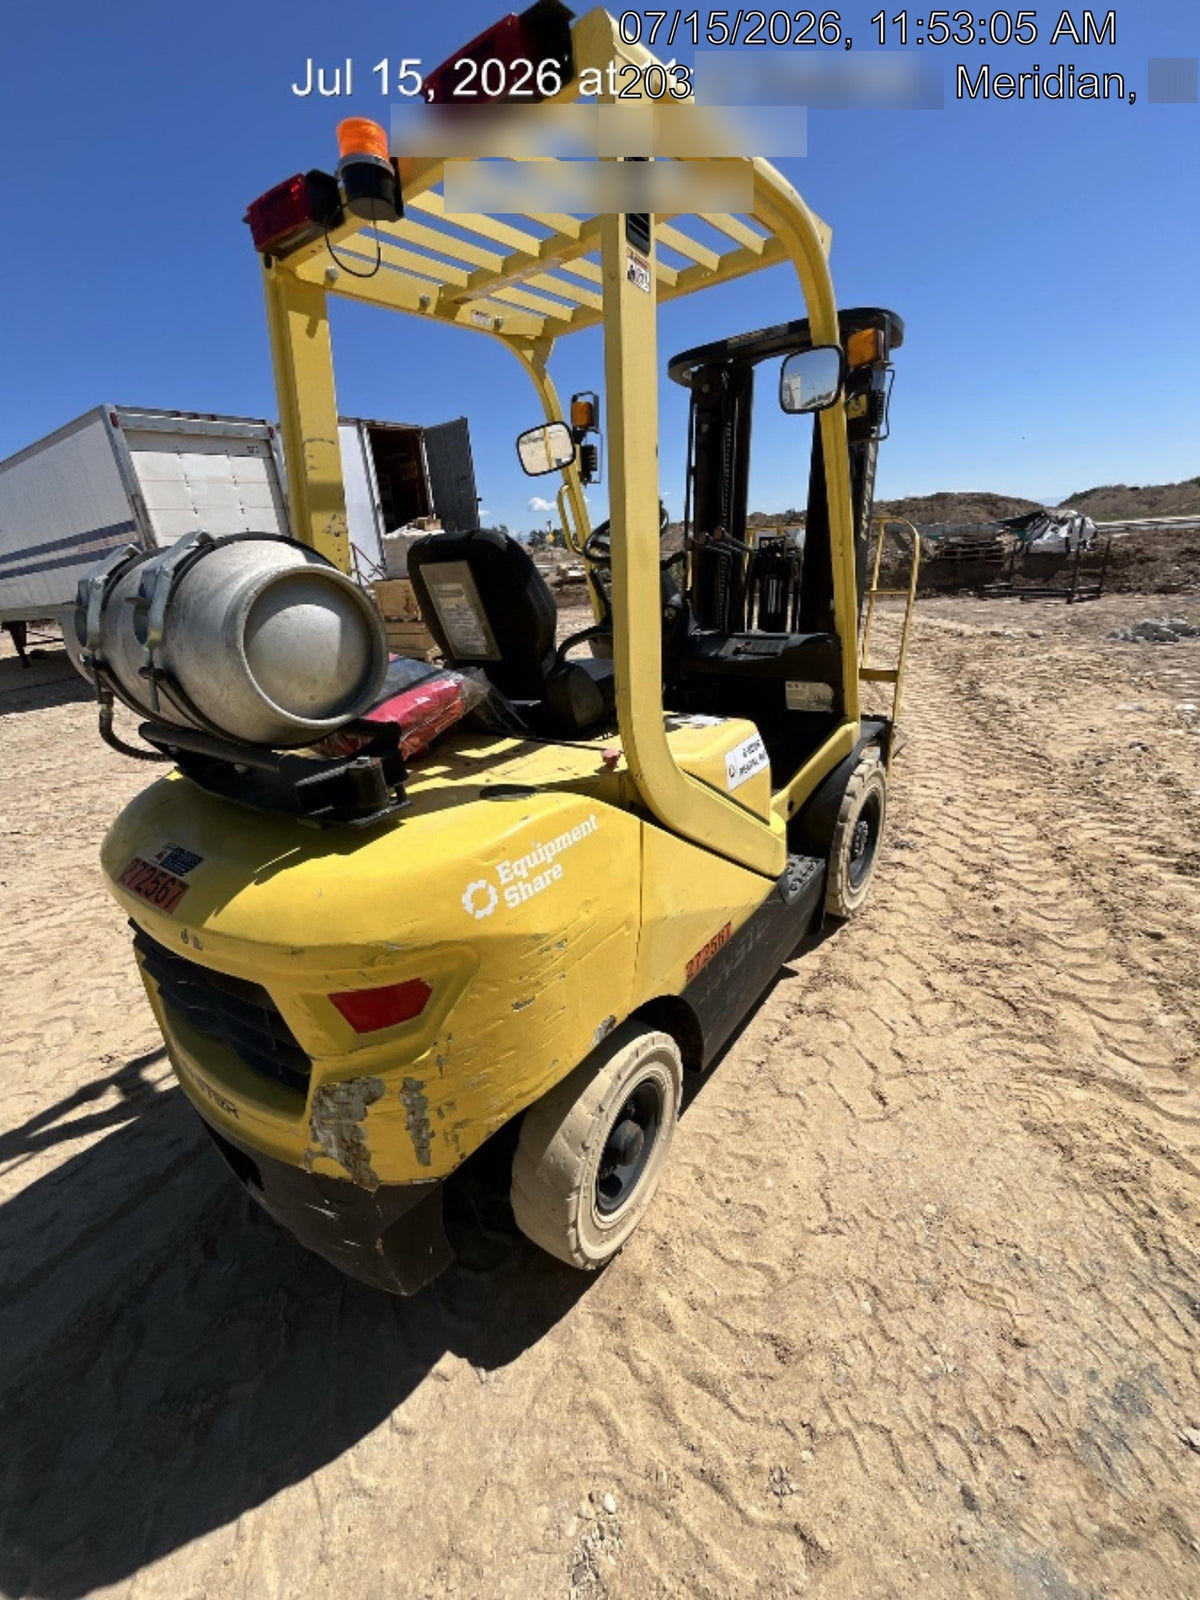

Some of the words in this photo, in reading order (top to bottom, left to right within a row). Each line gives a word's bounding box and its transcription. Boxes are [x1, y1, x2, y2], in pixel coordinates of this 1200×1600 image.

[496, 814, 598, 885] Equipment
[119, 857, 189, 910] 272567
[504, 864, 562, 908] Share
